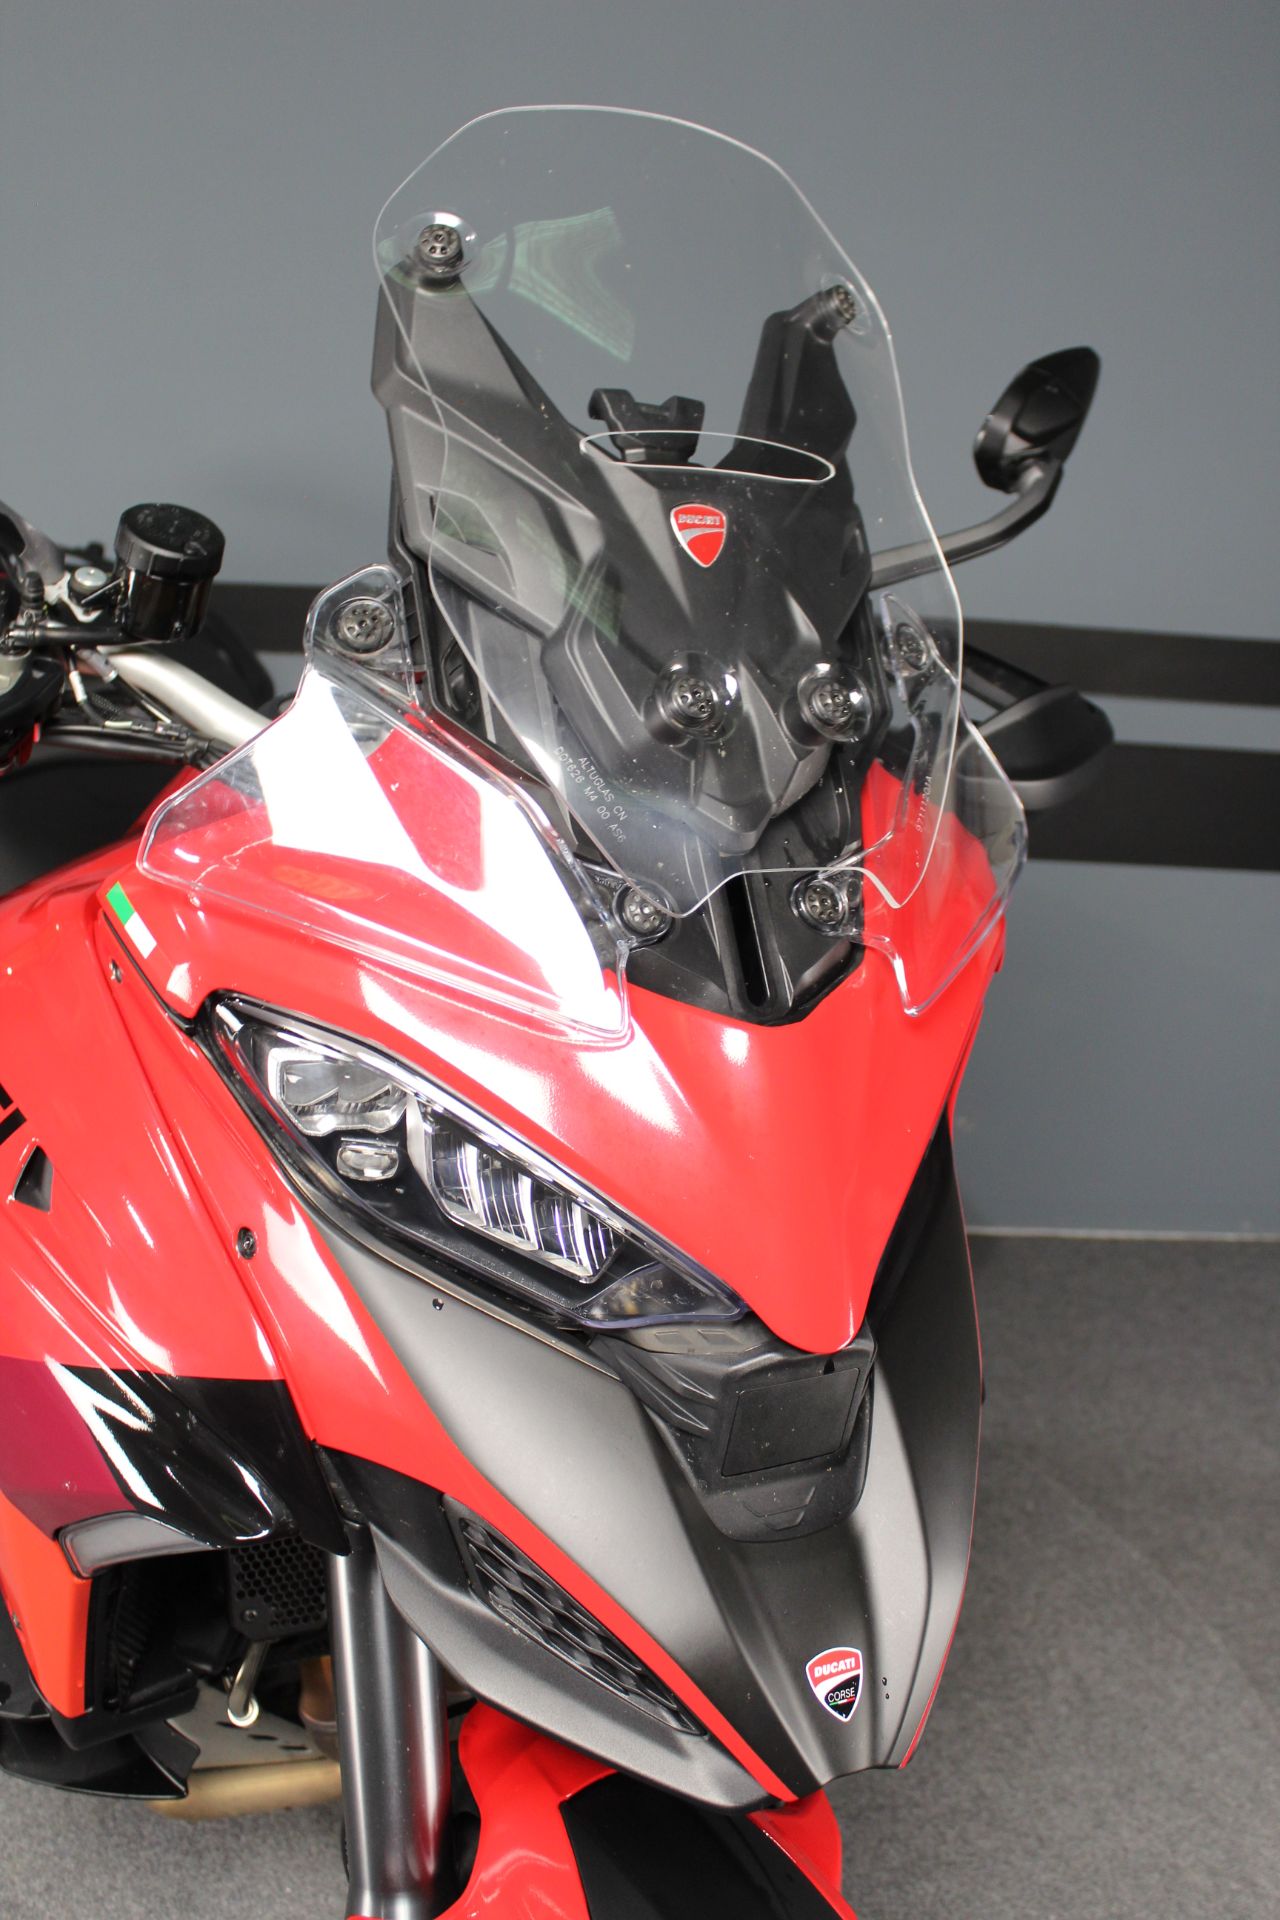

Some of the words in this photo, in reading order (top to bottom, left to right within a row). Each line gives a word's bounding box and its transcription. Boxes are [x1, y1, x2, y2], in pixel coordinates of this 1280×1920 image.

[678, 514, 720, 525] DUCATI
[553, 745, 586, 784] DOT626
[583, 785, 599, 803] M4
[607, 823, 627, 843] AS6
[578, 757, 616, 803] ALTUGLAS
[612, 805, 629, 822] CN
[814, 1657, 855, 1678] DUCATI
[827, 1686, 856, 1703] CORSE
